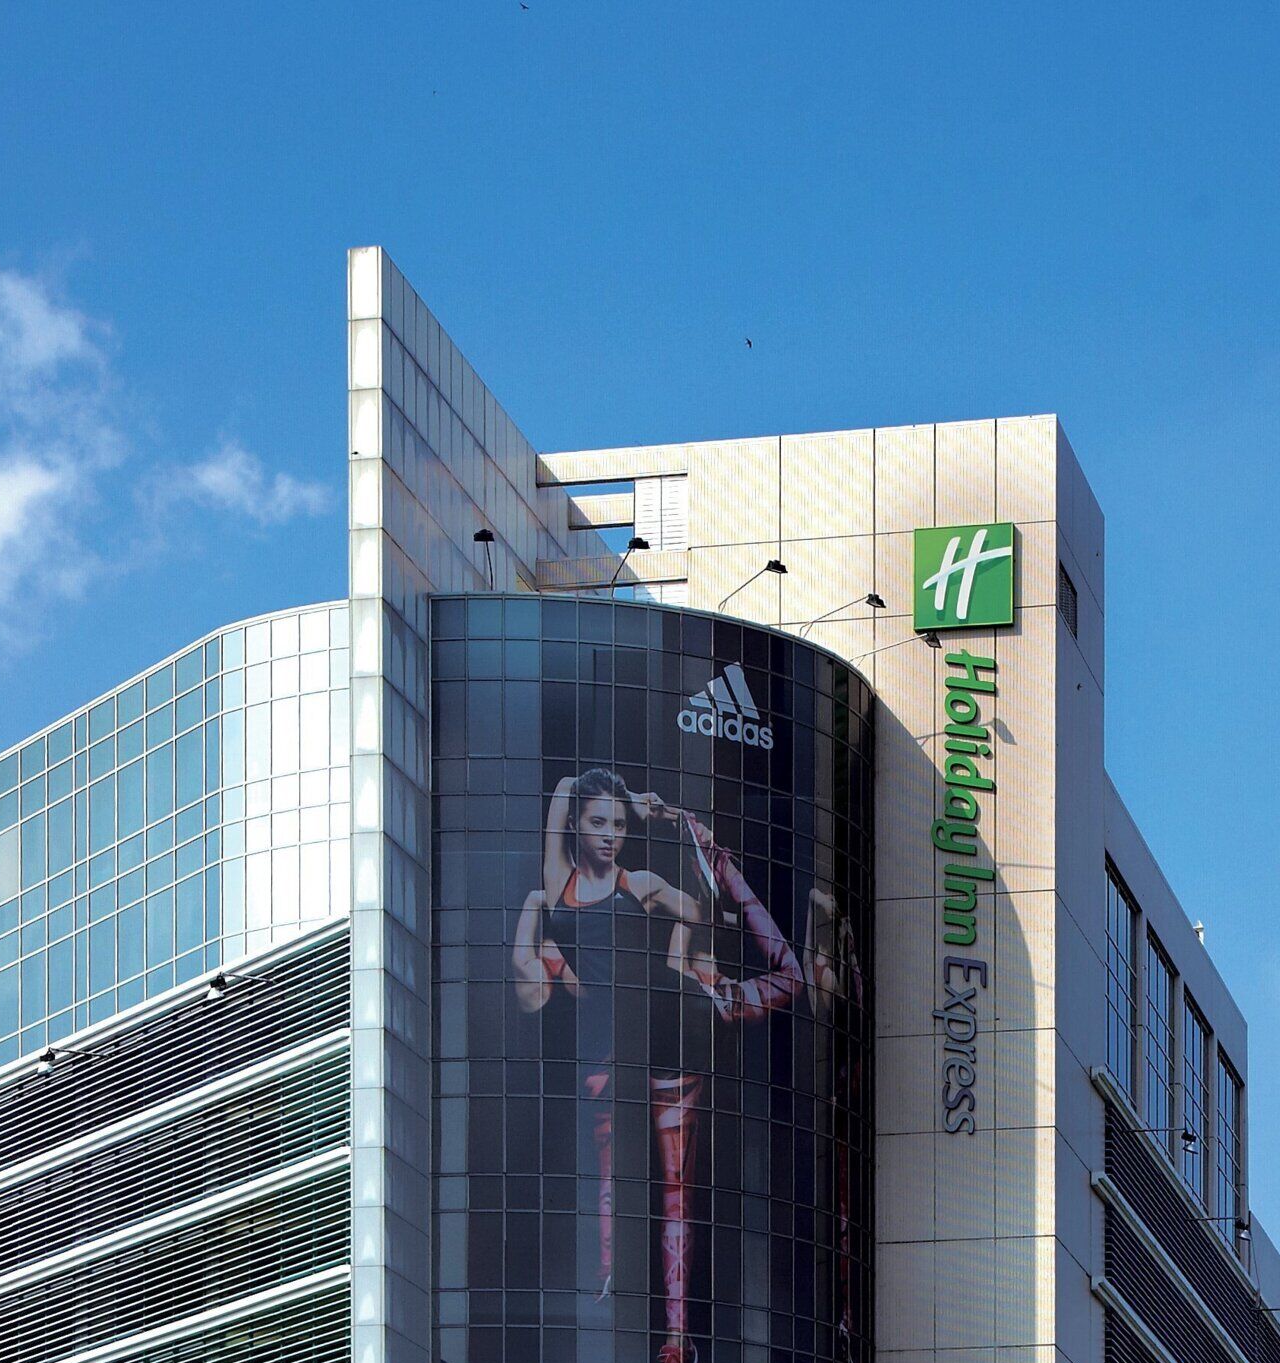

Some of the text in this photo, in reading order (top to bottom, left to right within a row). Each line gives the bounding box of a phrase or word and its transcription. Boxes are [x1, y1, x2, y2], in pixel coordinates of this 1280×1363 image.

[677, 708, 774, 750] adidas
[930, 648, 997, 1136] Holiday Inn Express
